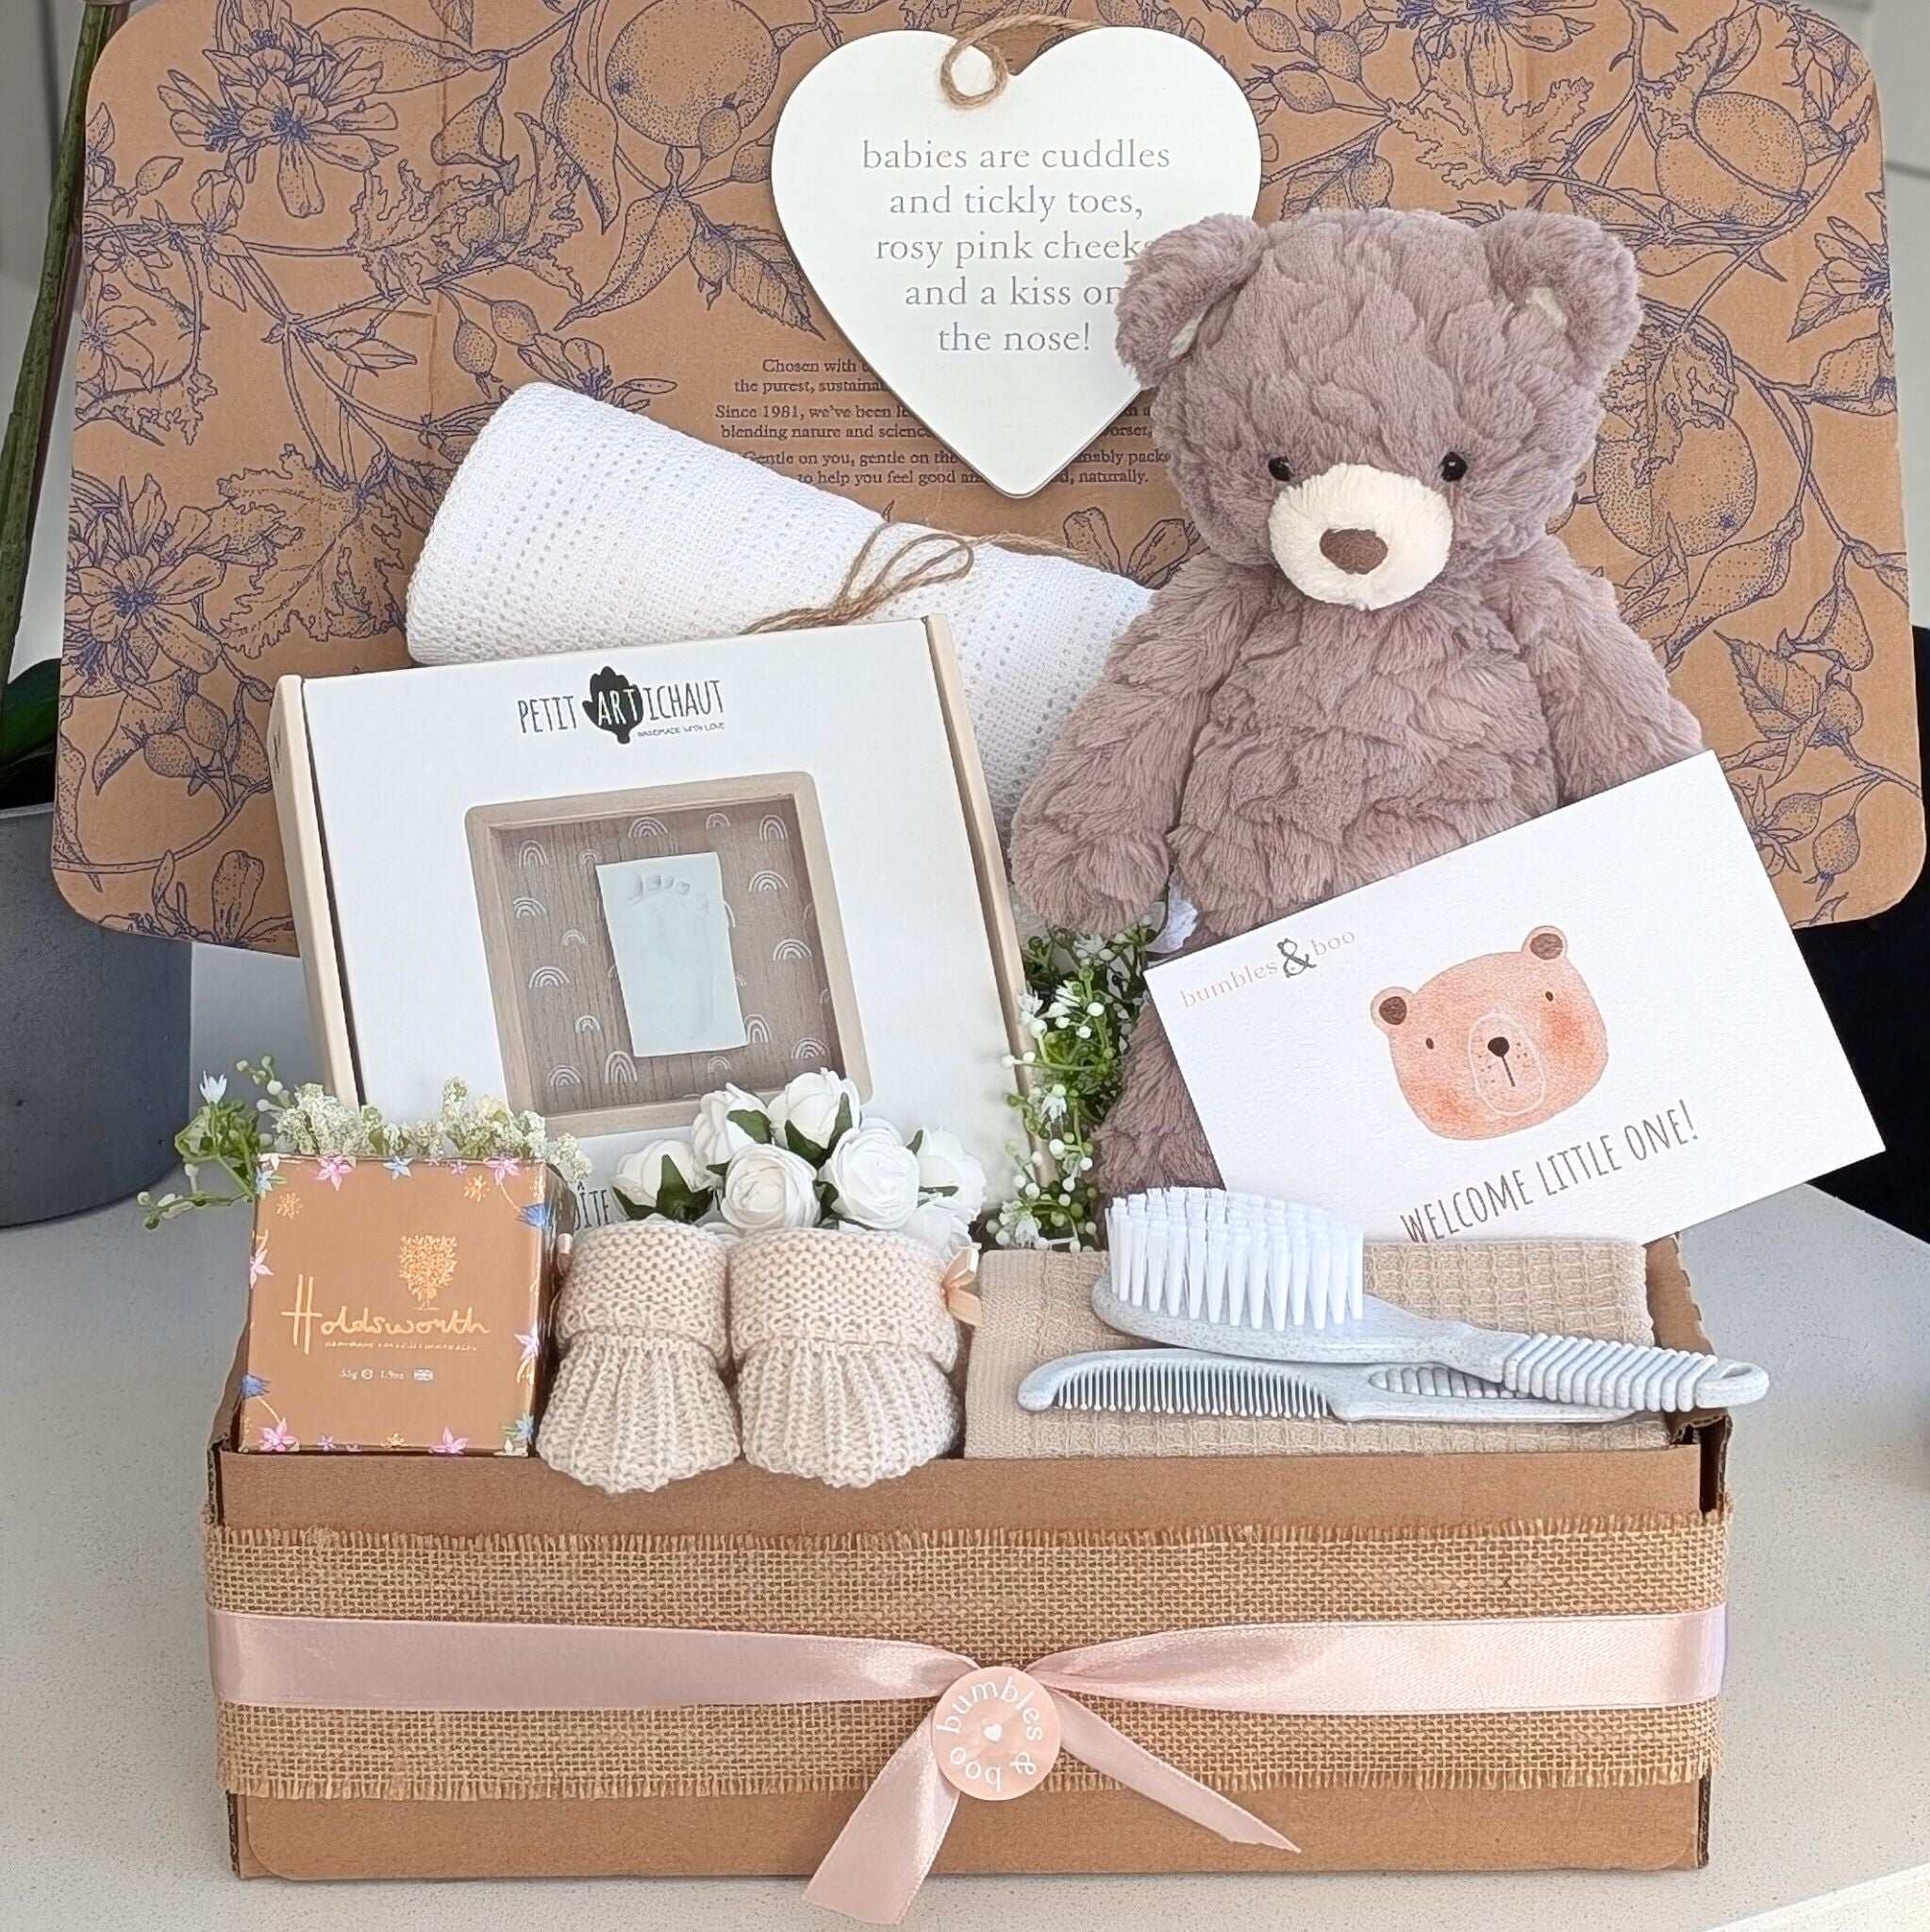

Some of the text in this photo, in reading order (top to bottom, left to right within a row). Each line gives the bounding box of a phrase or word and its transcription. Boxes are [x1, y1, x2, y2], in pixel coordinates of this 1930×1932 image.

[862, 139, 1170, 168] babies are cuddles
[890, 184, 1142, 223] and tickly toes,
[877, 240, 942, 268] rosy
[956, 230, 1033, 269] pink
[905, 276, 966, 305] and
[981, 286, 996, 305] a
[1010, 275, 1071, 305] kiss
[939, 322, 1090, 351] the nose!
[762, 358, 819, 373] Chosen
[824, 358, 857, 373] with
[735, 378, 757, 392] the
[762, 381, 815, 394] purest,
[715, 405, 757, 418] Since
[762, 405, 805, 420] 1981,
[808, 405, 852, 418] we've
[855, 405, 891, 418] been
[720, 425, 788, 441] blending
[790, 427, 840, 438] nature
[845, 425, 873, 438] and
[799, 454, 819, 464] on
[823, 454, 855, 467] you,
[859, 451, 905, 467] gentle
[910, 454, 929, 464] on
[818, 470, 849, 486] help
[855, 473, 883, 486] you
[888, 470, 913, 484] feel
[919, 471, 957, 487] good
[1078, 469, 1148, 484] naturally.
[518, 695, 577, 733] PETIT
[1180, 931, 1356, 1008] bumbles & boo
[1400, 1099, 1699, 1243] WELCOME LITTLE ONE!
[280, 1274, 491, 1355] Holdsworth
[936, 1675, 1042, 1792] bumbles & boo
